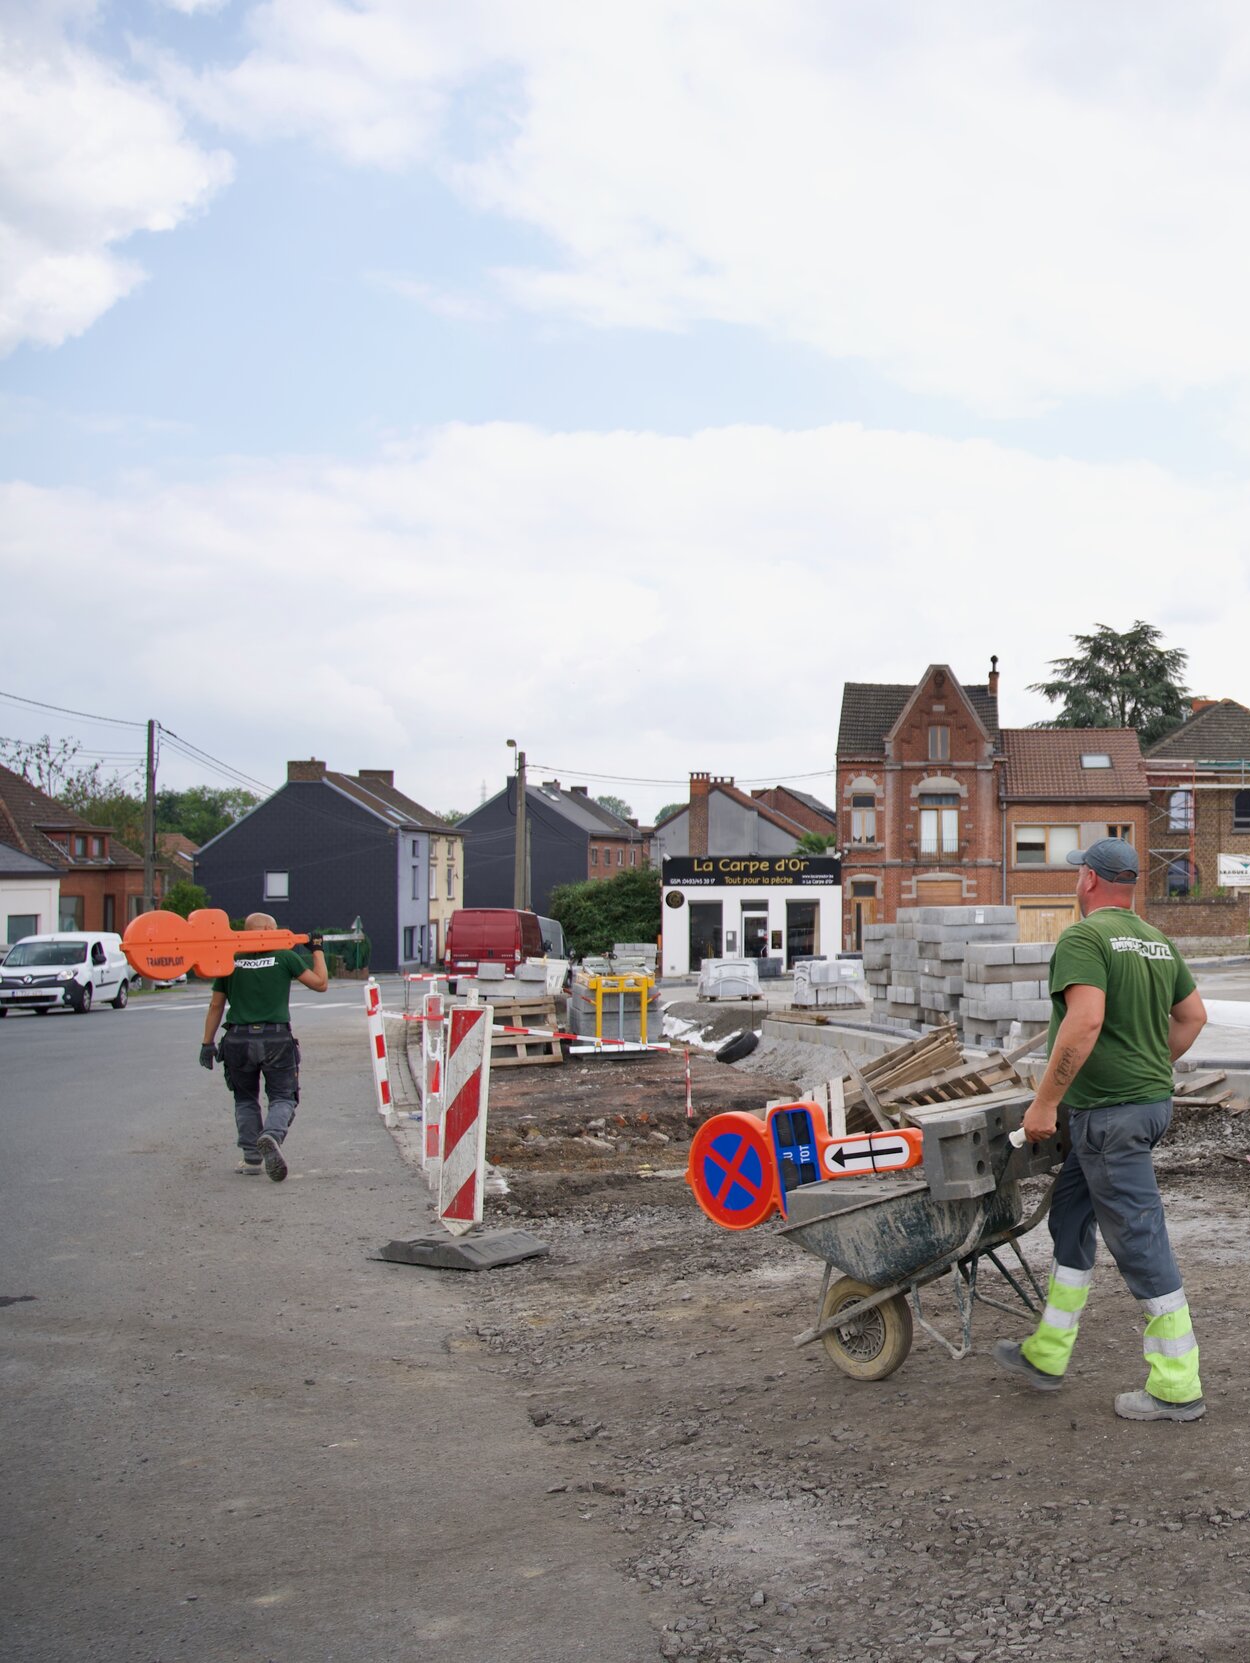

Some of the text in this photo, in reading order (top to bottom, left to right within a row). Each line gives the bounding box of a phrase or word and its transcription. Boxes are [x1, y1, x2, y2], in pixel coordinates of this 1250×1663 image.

[693, 858, 810, 874] La Carpe d'Or
[724, 875, 793, 886] Tout pour la pêche
[799, 1145, 811, 1164] TOT
